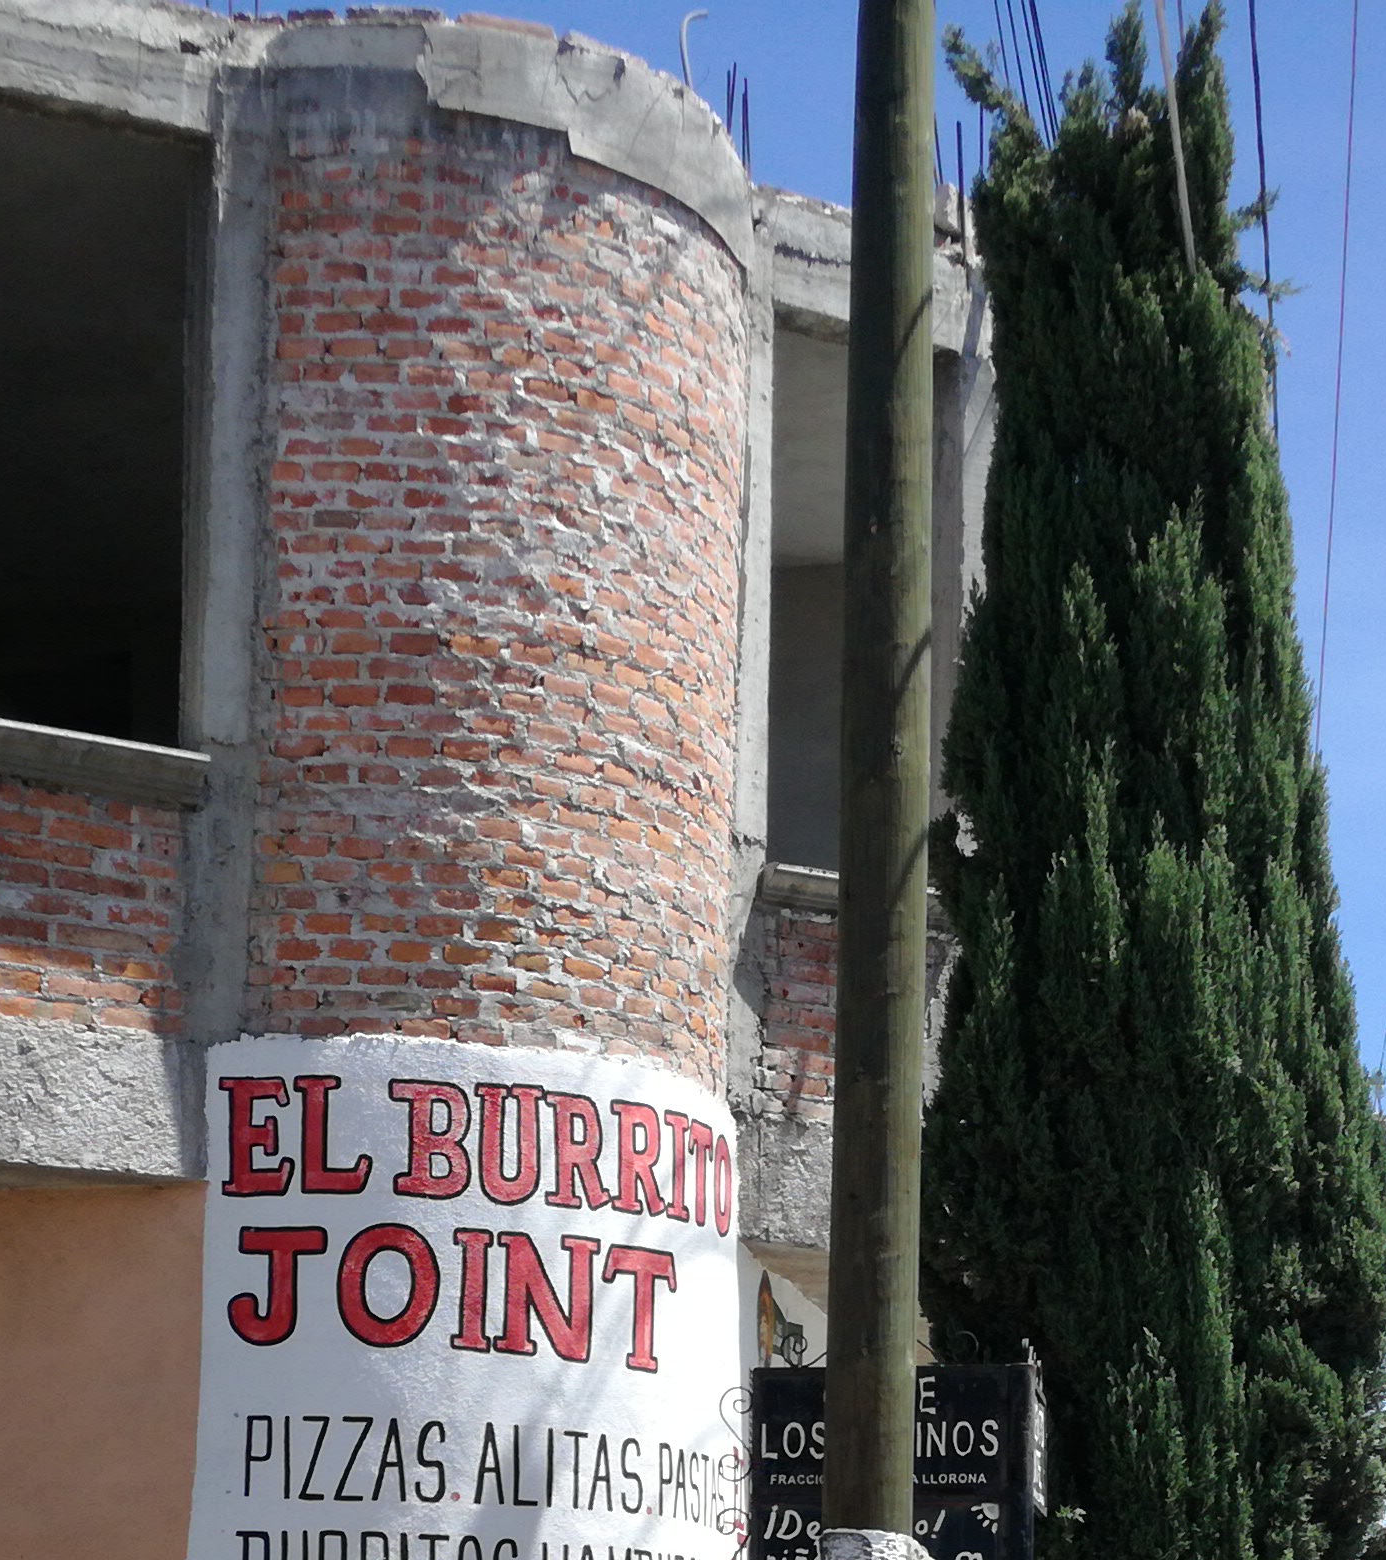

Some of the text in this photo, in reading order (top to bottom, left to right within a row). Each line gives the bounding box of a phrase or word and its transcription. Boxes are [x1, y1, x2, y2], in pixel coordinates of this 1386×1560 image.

[219, 1075, 732, 1238] EL BURRITO
[227, 1223, 677, 1374] JOINT
[761, 1421, 825, 1460] LOS
[922, 1473, 987, 1485] LLORONA
